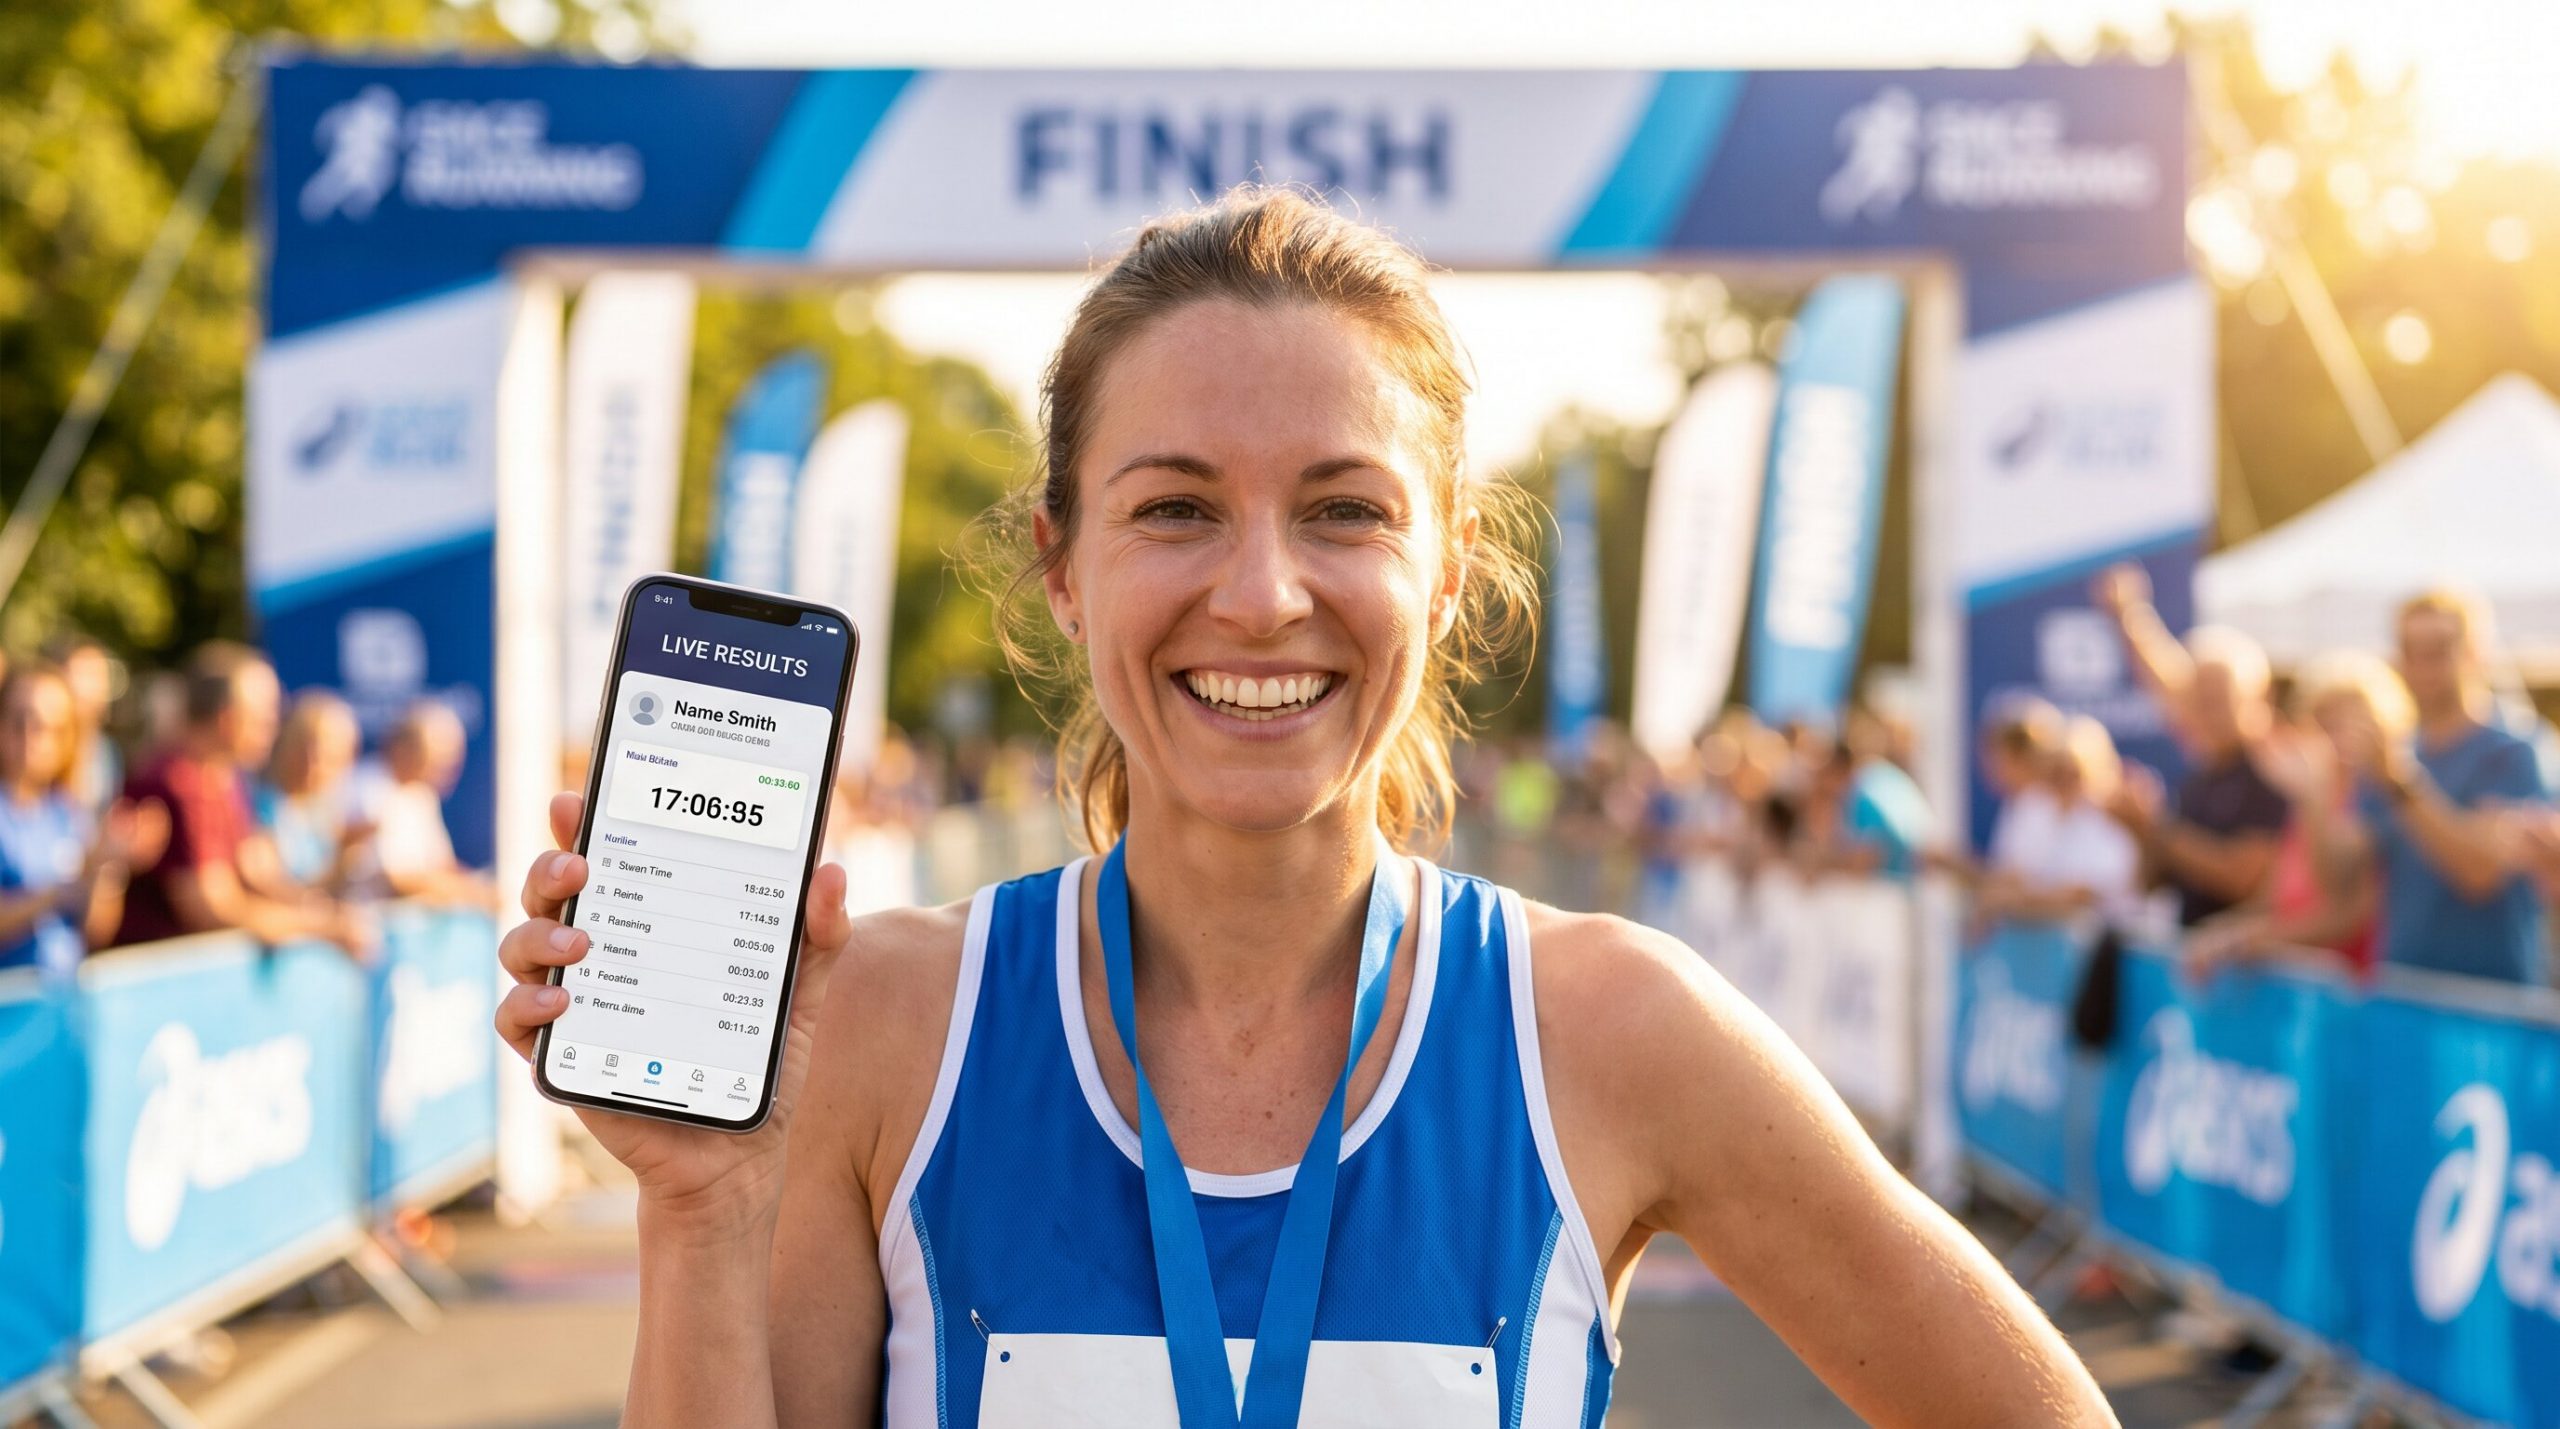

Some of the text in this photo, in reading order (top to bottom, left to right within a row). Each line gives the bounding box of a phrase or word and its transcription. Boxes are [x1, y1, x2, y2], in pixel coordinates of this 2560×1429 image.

[1016, 104, 1451, 198] FINISH
[661, 634, 809, 678] LIVE RESULTS
[673, 700, 778, 733] Name Smith
[649, 866, 673, 879] Time
